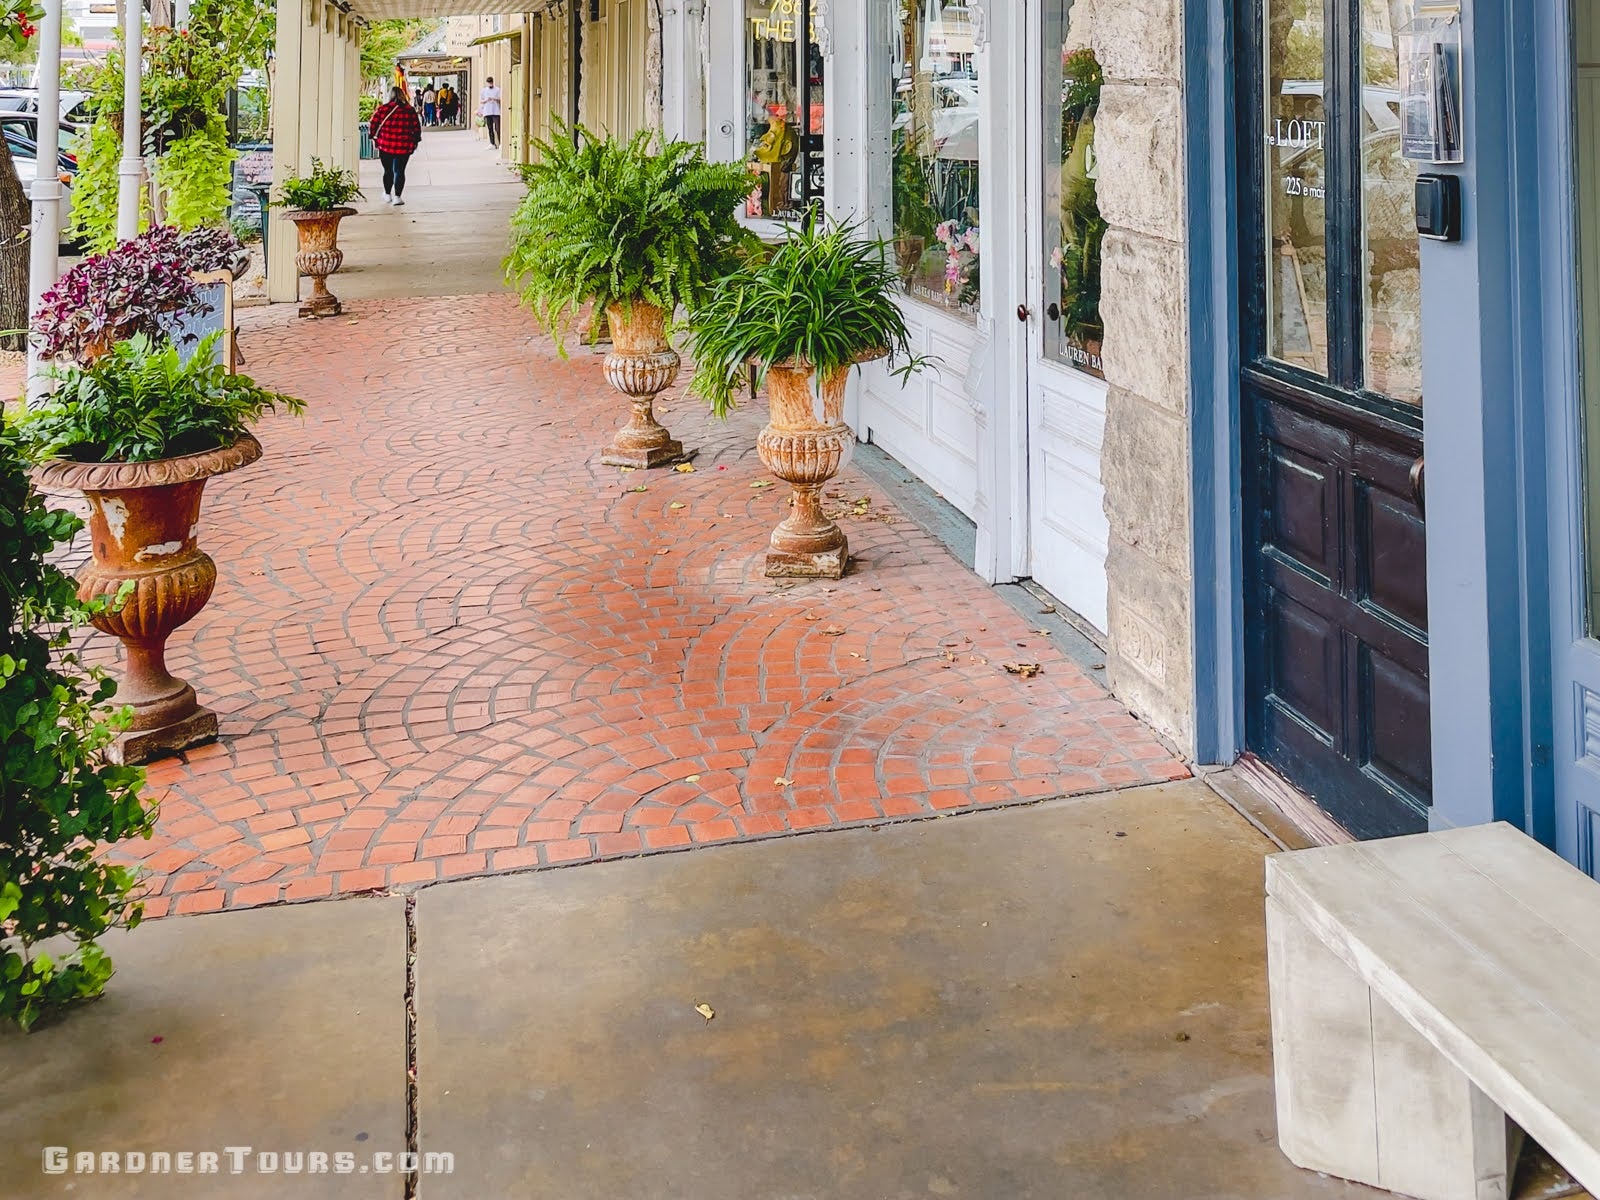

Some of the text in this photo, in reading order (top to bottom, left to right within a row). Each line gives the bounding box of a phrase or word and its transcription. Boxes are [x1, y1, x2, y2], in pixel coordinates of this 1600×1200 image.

[751, 18, 794, 42] THE
[1275, 119, 1326, 150] LOFT
[1286, 176, 1301, 196] 225
[1303, 188, 1308, 196] e
[1059, 343, 1104, 371] LAUREN BA
